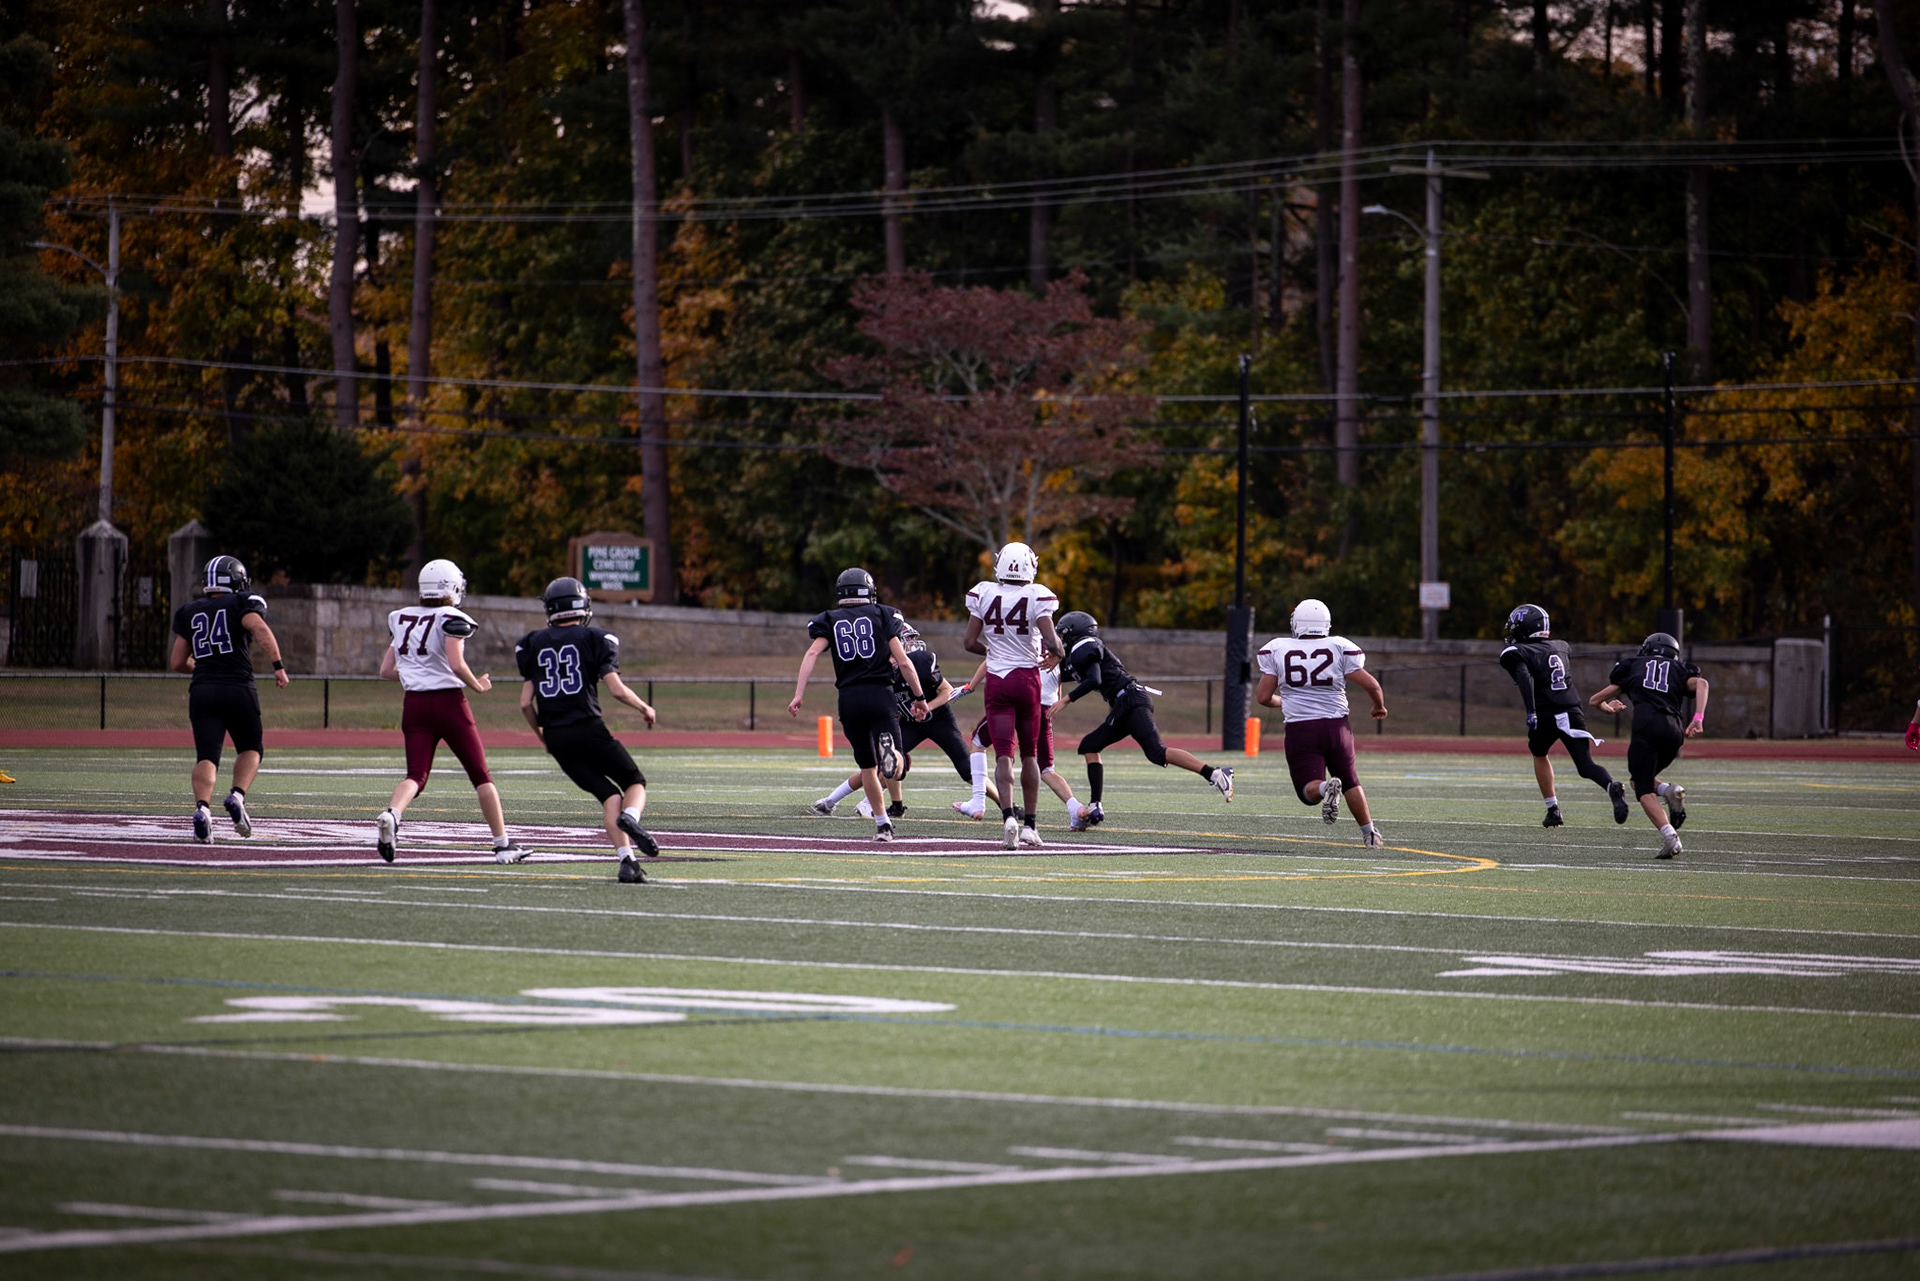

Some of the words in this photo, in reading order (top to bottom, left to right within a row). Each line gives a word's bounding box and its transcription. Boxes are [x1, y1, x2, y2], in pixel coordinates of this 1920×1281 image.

[588, 546, 607, 559] PINE
[609, 546, 640, 559] GROVE
[592, 560, 635, 571] CEMETERY
[1008, 563, 1020, 572] 44
[191, 609, 233, 659] 24
[398, 613, 436, 655] 77
[983, 595, 1029, 635] 44
[833, 616, 876, 662] 68
[537, 644, 583, 698] 33
[1284, 648, 1333, 687] 62
[1548, 654, 1568, 690] 2
[1643, 660, 1670, 693] 11
